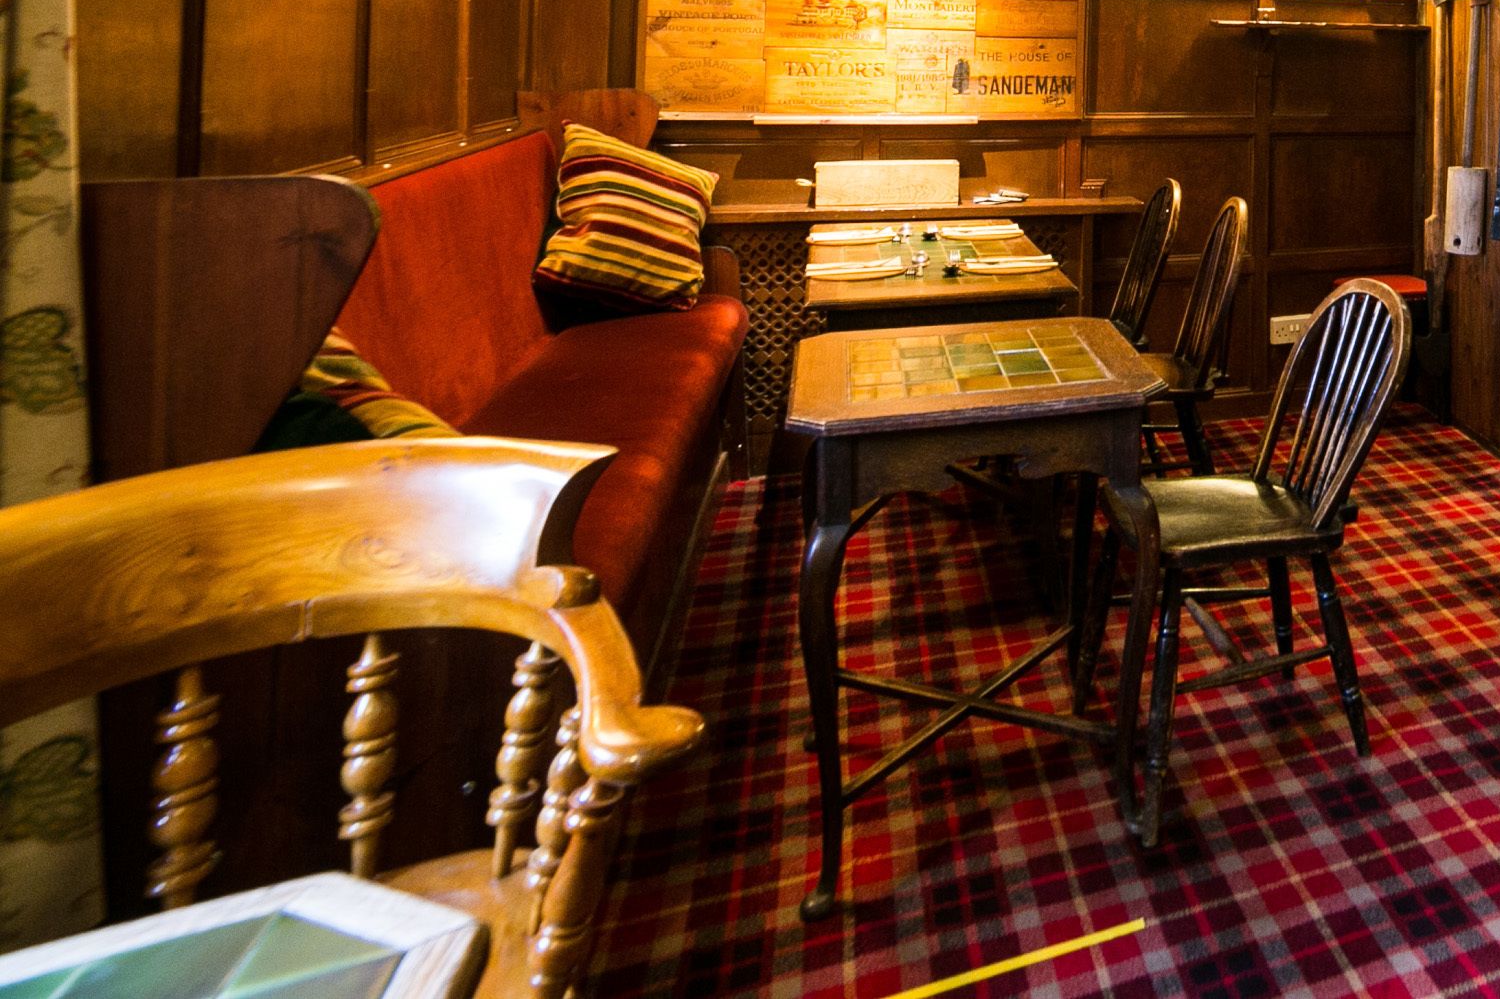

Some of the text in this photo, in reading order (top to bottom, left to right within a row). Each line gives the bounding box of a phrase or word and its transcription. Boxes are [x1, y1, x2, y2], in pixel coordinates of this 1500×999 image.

[713, 26, 764, 34] PORTUGAL
[980, 52, 1072, 62] THE HOUSE OF
[784, 61, 886, 77] TAYLOR'S
[978, 75, 1072, 95] SANDEMAN
